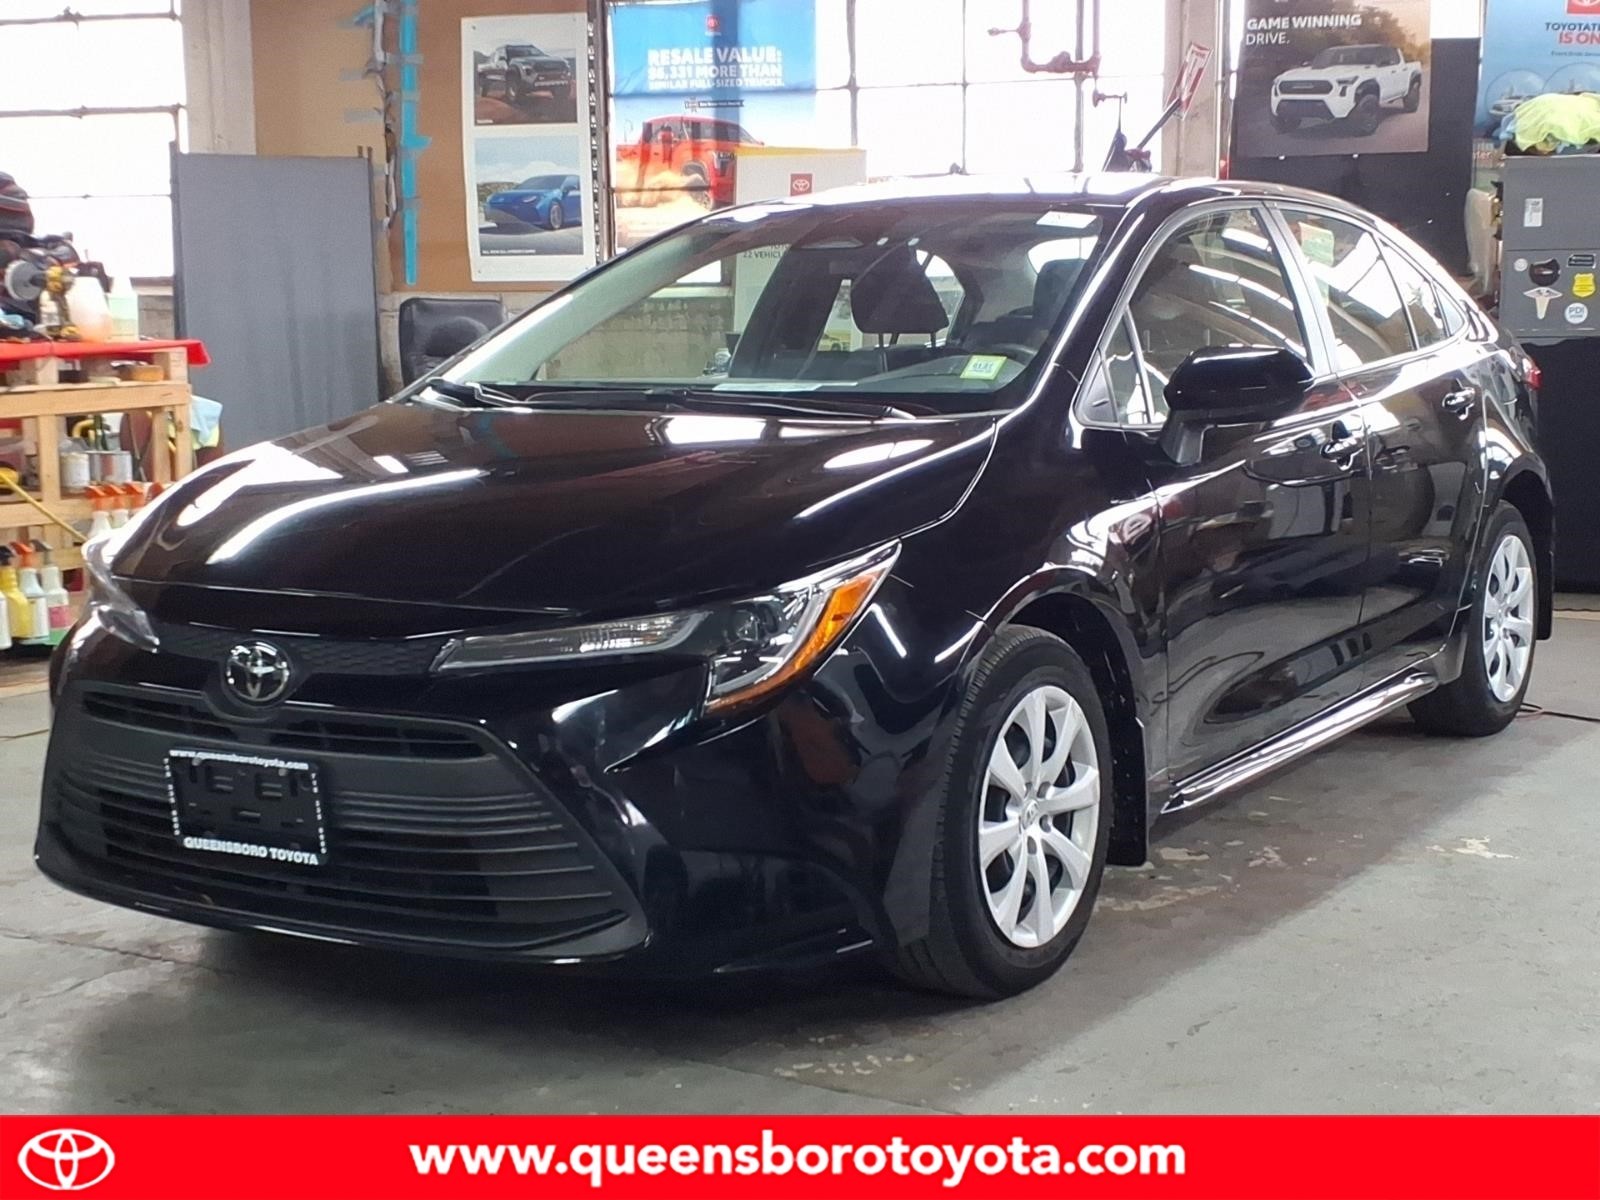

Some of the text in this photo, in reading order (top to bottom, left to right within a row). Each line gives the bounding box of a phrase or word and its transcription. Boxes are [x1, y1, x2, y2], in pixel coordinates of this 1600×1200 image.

[1247, 14, 1362, 30] GAME WINNING
[1559, 32, 1573, 44] IS
[647, 46, 782, 65] RESALE VALUE:
[695, 65, 737, 79] MORE
[740, 64, 783, 78] THAN
[183, 837, 319, 865] QUEENSBORO TOYOTA
